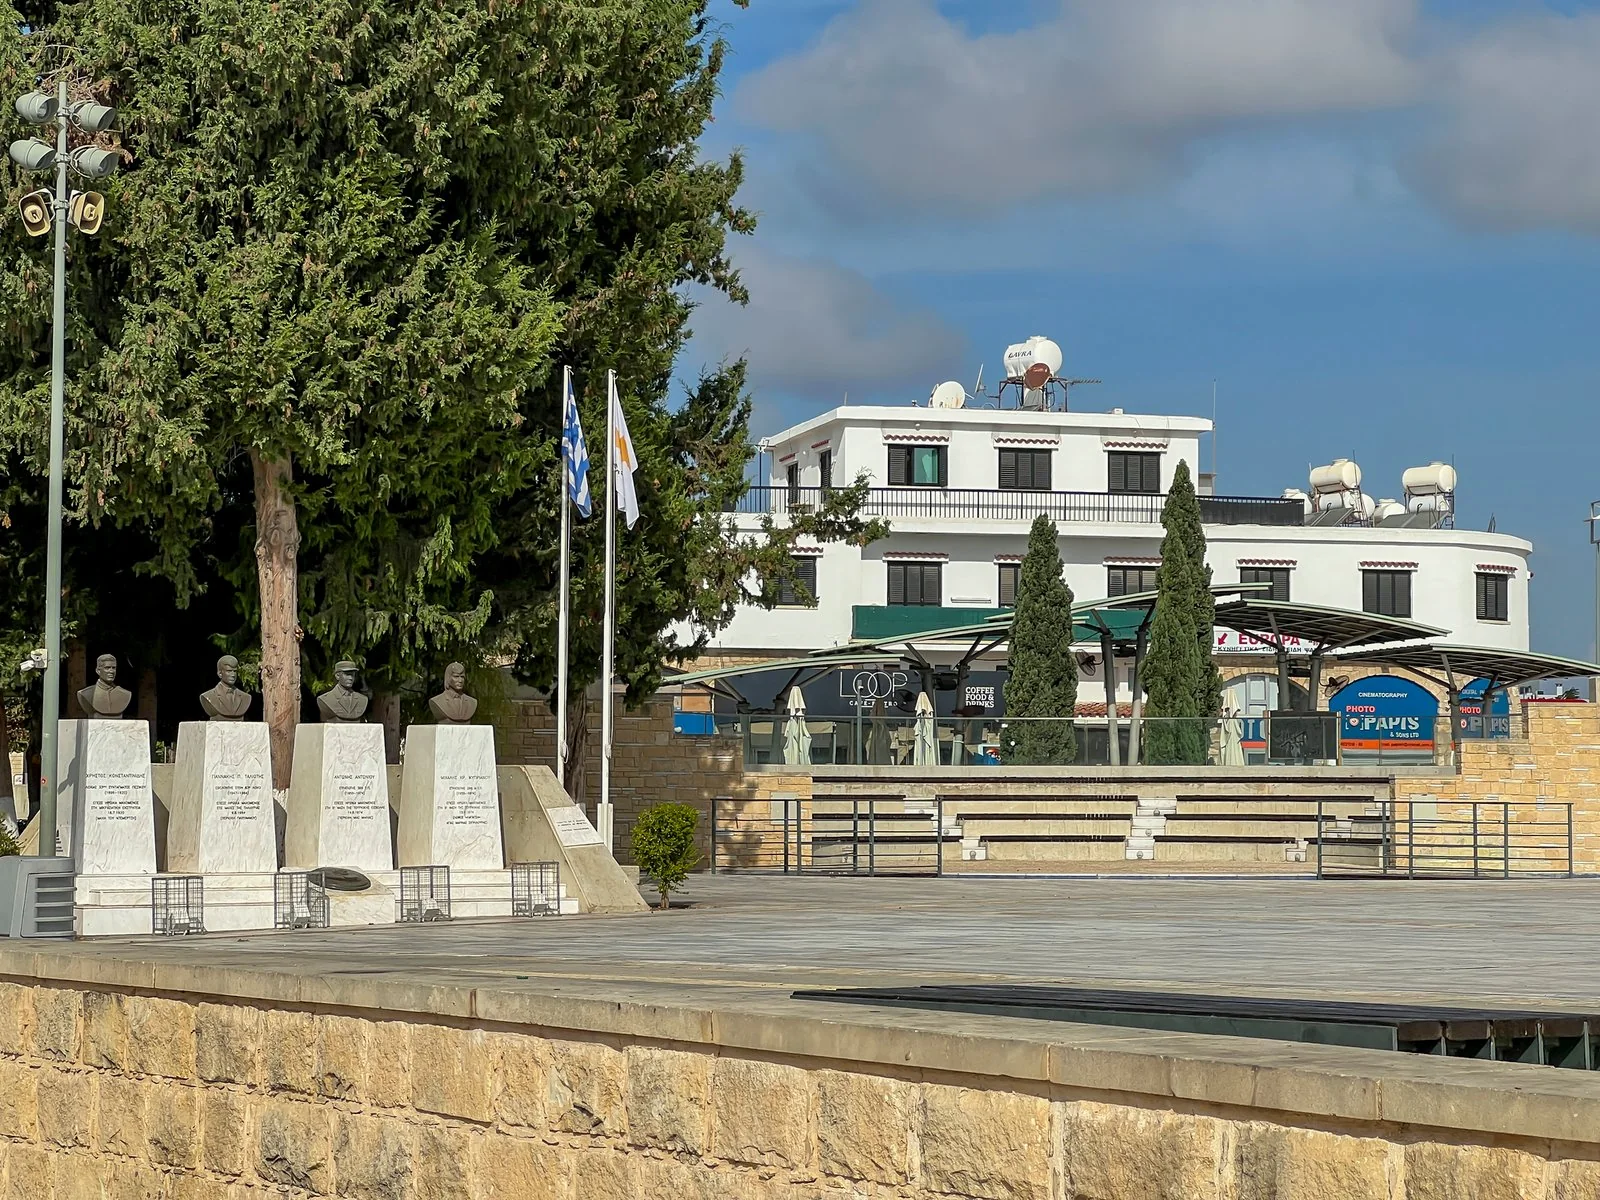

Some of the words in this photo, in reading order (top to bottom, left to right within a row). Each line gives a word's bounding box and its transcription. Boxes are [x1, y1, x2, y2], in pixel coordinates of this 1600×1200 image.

[839, 671, 908, 699] LOOP
[1346, 705, 1376, 713] PHOTO
[1364, 715, 1420, 731] PAPIS
[1470, 717, 1509, 732] PPIS
